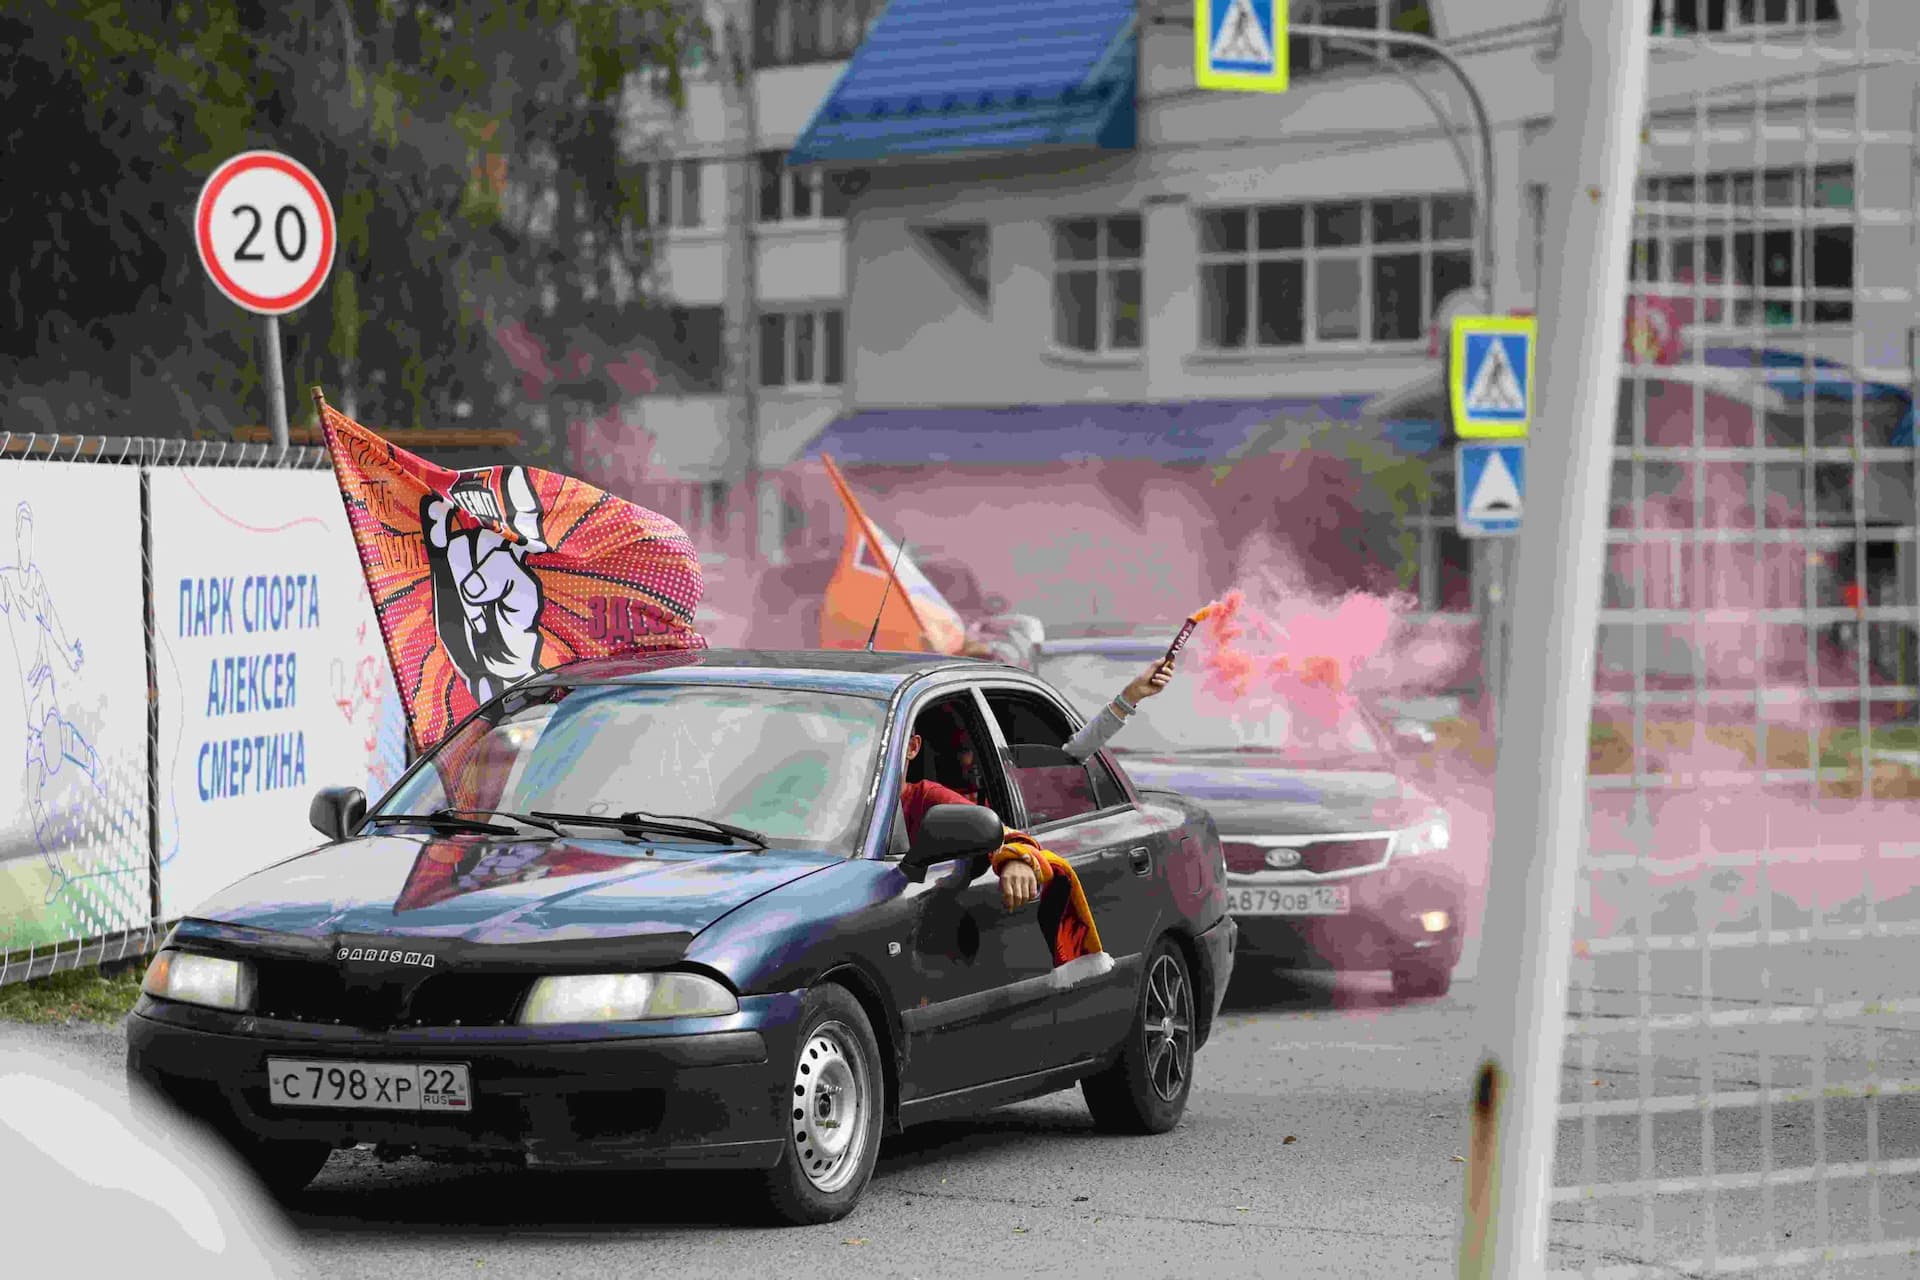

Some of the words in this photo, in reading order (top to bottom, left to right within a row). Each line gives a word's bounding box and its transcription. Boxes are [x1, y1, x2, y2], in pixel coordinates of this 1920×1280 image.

[232, 205, 307, 262] 20
[179, 577, 234, 638] ПАРК
[242, 575, 320, 633] СПОРТА
[206, 652, 297, 717] АЛЕКСЕЯ
[197, 731, 306, 802] СМЕРТИНА
[337, 947, 435, 968] CARISMA
[423, 1069, 456, 1095] 22
[423, 1095, 447, 1105] RUS
